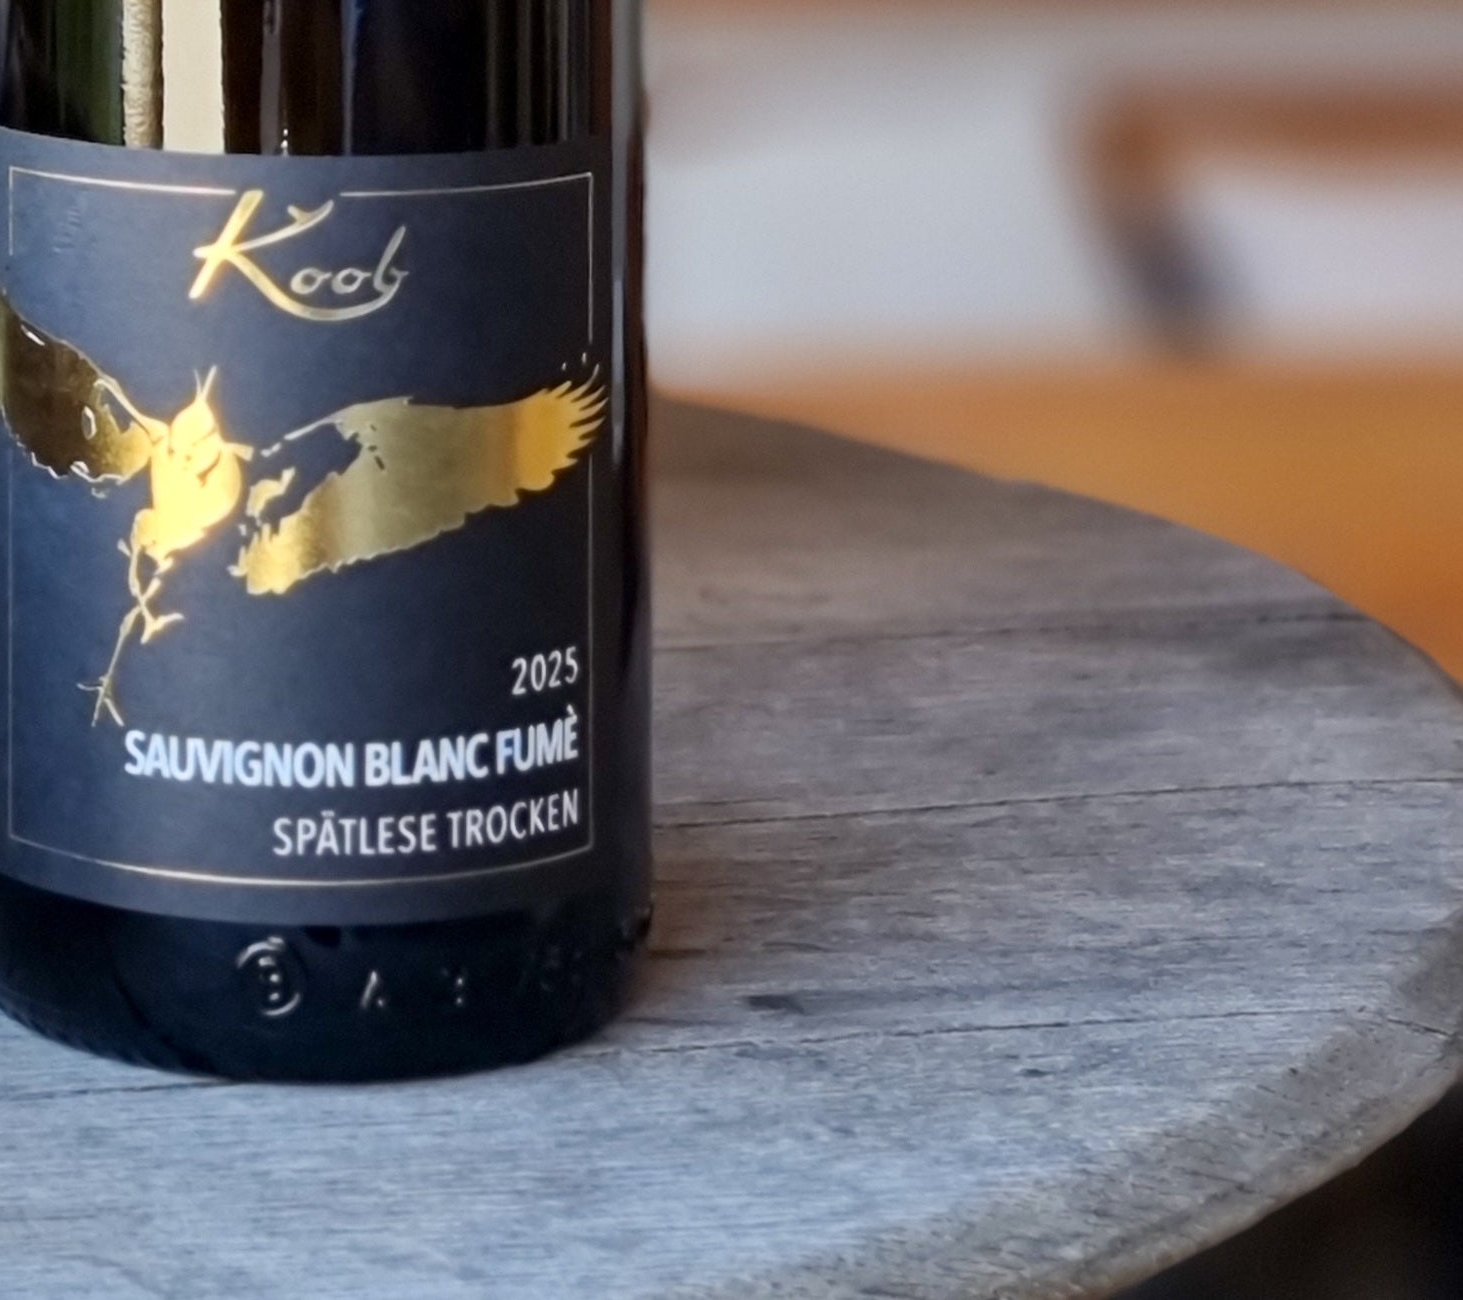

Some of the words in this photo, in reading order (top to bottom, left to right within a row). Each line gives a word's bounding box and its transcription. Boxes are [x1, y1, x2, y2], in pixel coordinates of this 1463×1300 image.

[189, 190, 409, 321] Koob
[511, 646, 579, 695] 2025
[124, 730, 355, 788] SAUVIGNON
[365, 733, 489, 787] BLANC
[273, 809, 436, 857] SPÄTLESE
[447, 789, 579, 848] TROCKEN
